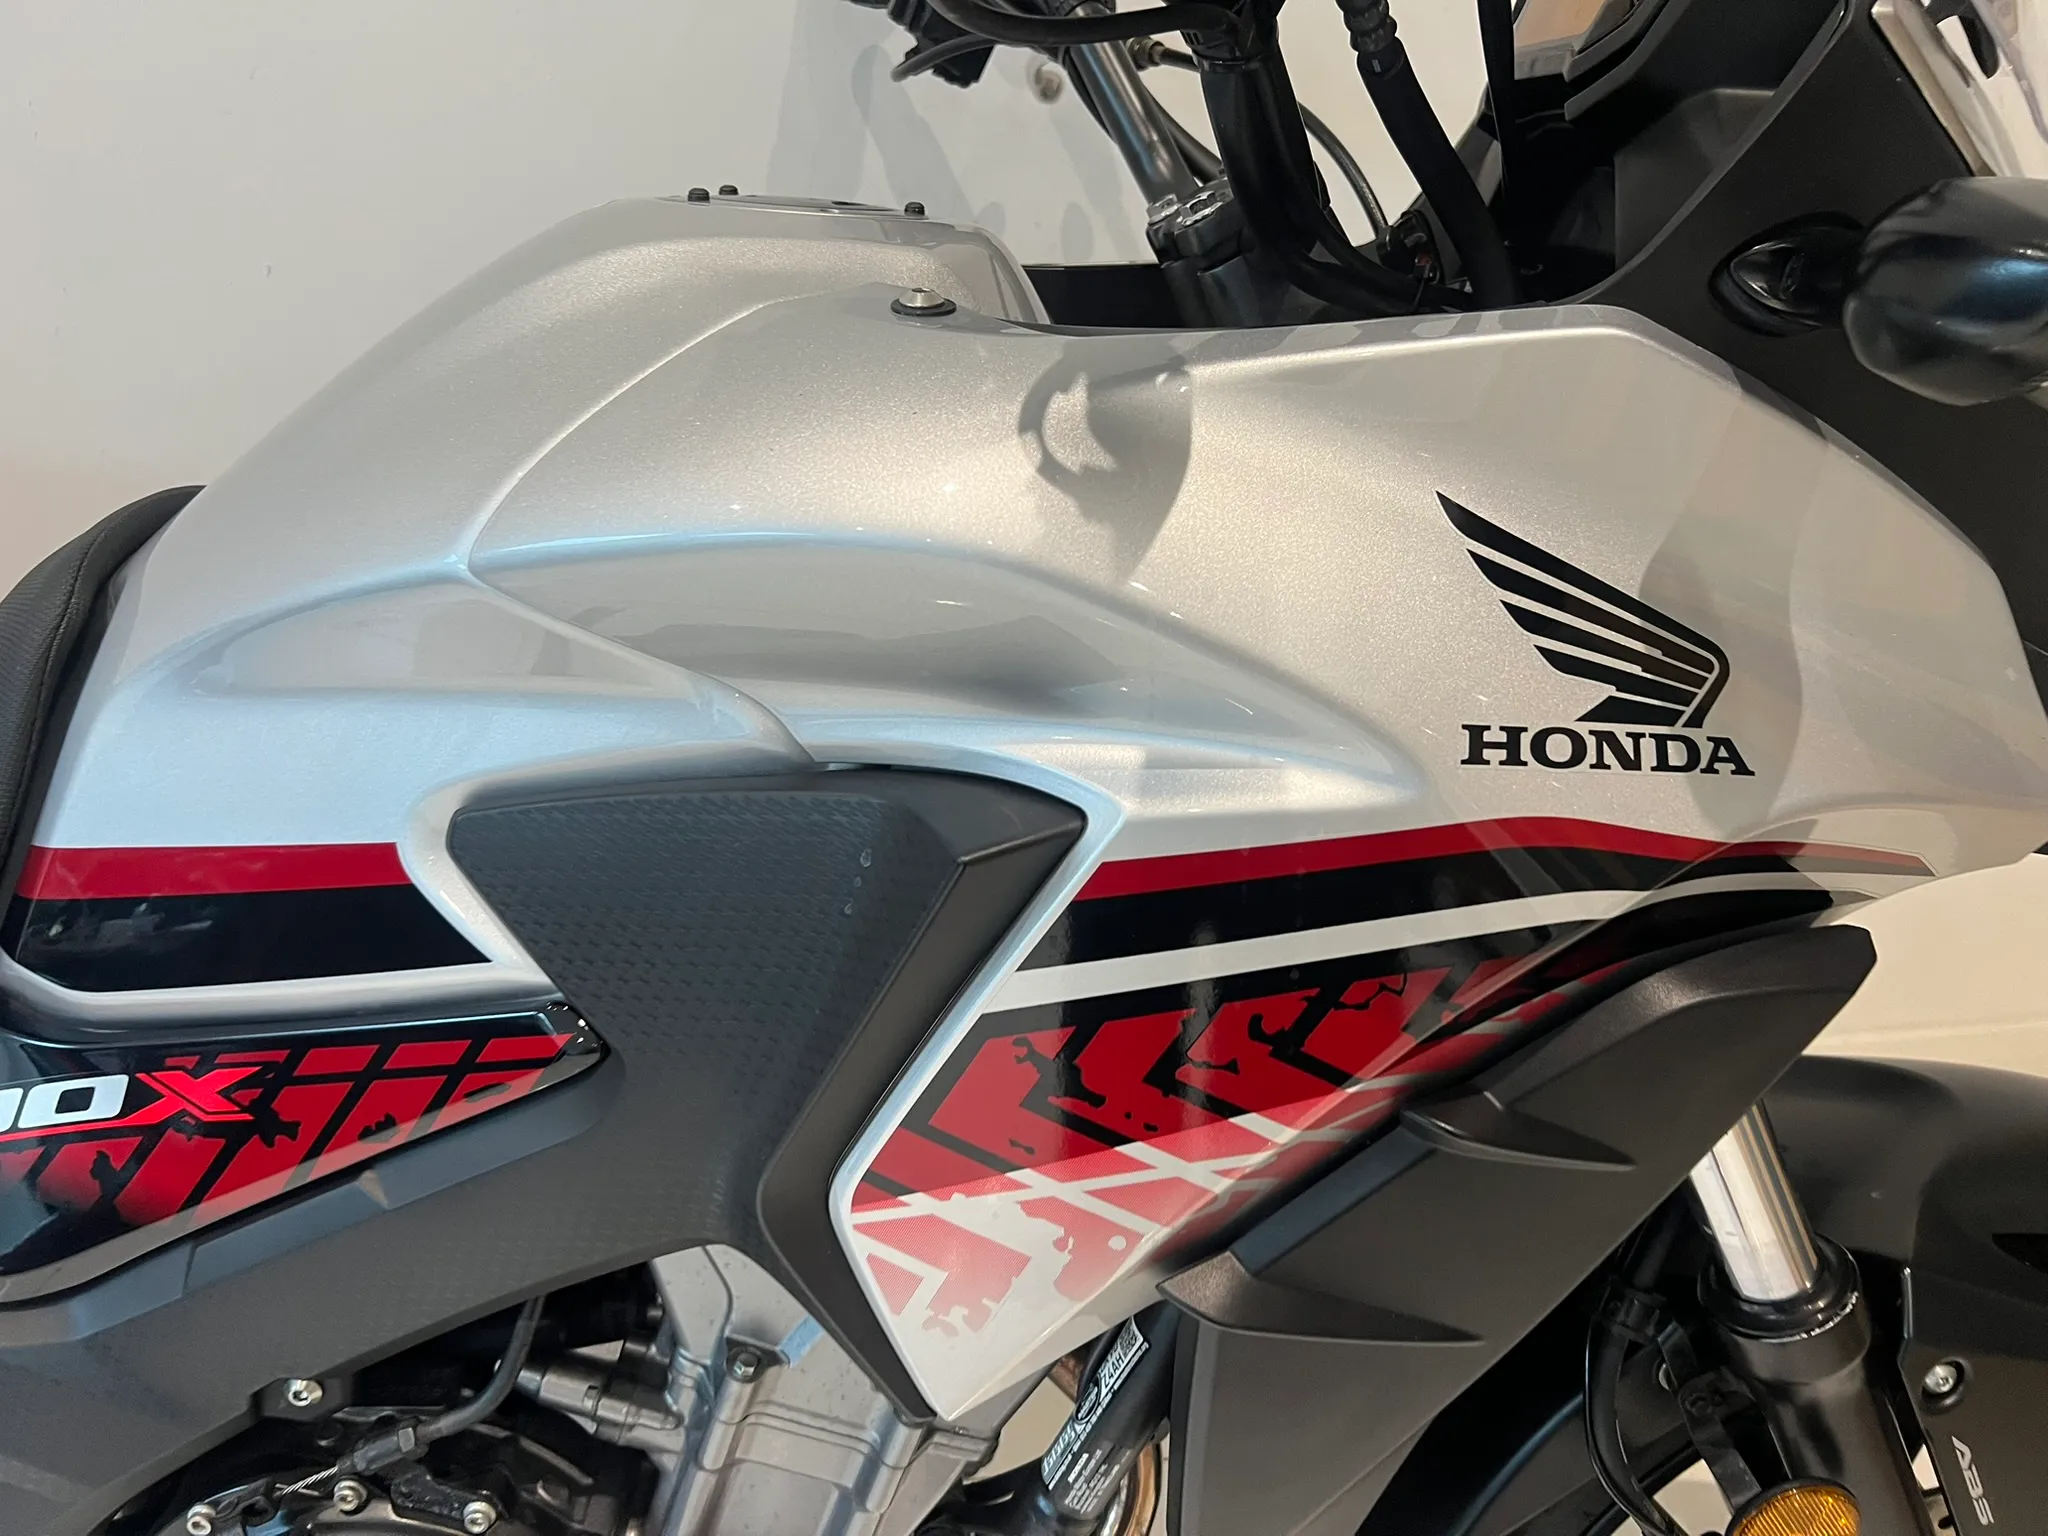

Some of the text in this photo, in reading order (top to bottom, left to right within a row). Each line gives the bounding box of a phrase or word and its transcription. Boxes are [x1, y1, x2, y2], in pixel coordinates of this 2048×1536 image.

[1460, 724, 1756, 776] HONDA
[0, 1066, 263, 1138] 0X
[1952, 1436, 1995, 1526] ABS
